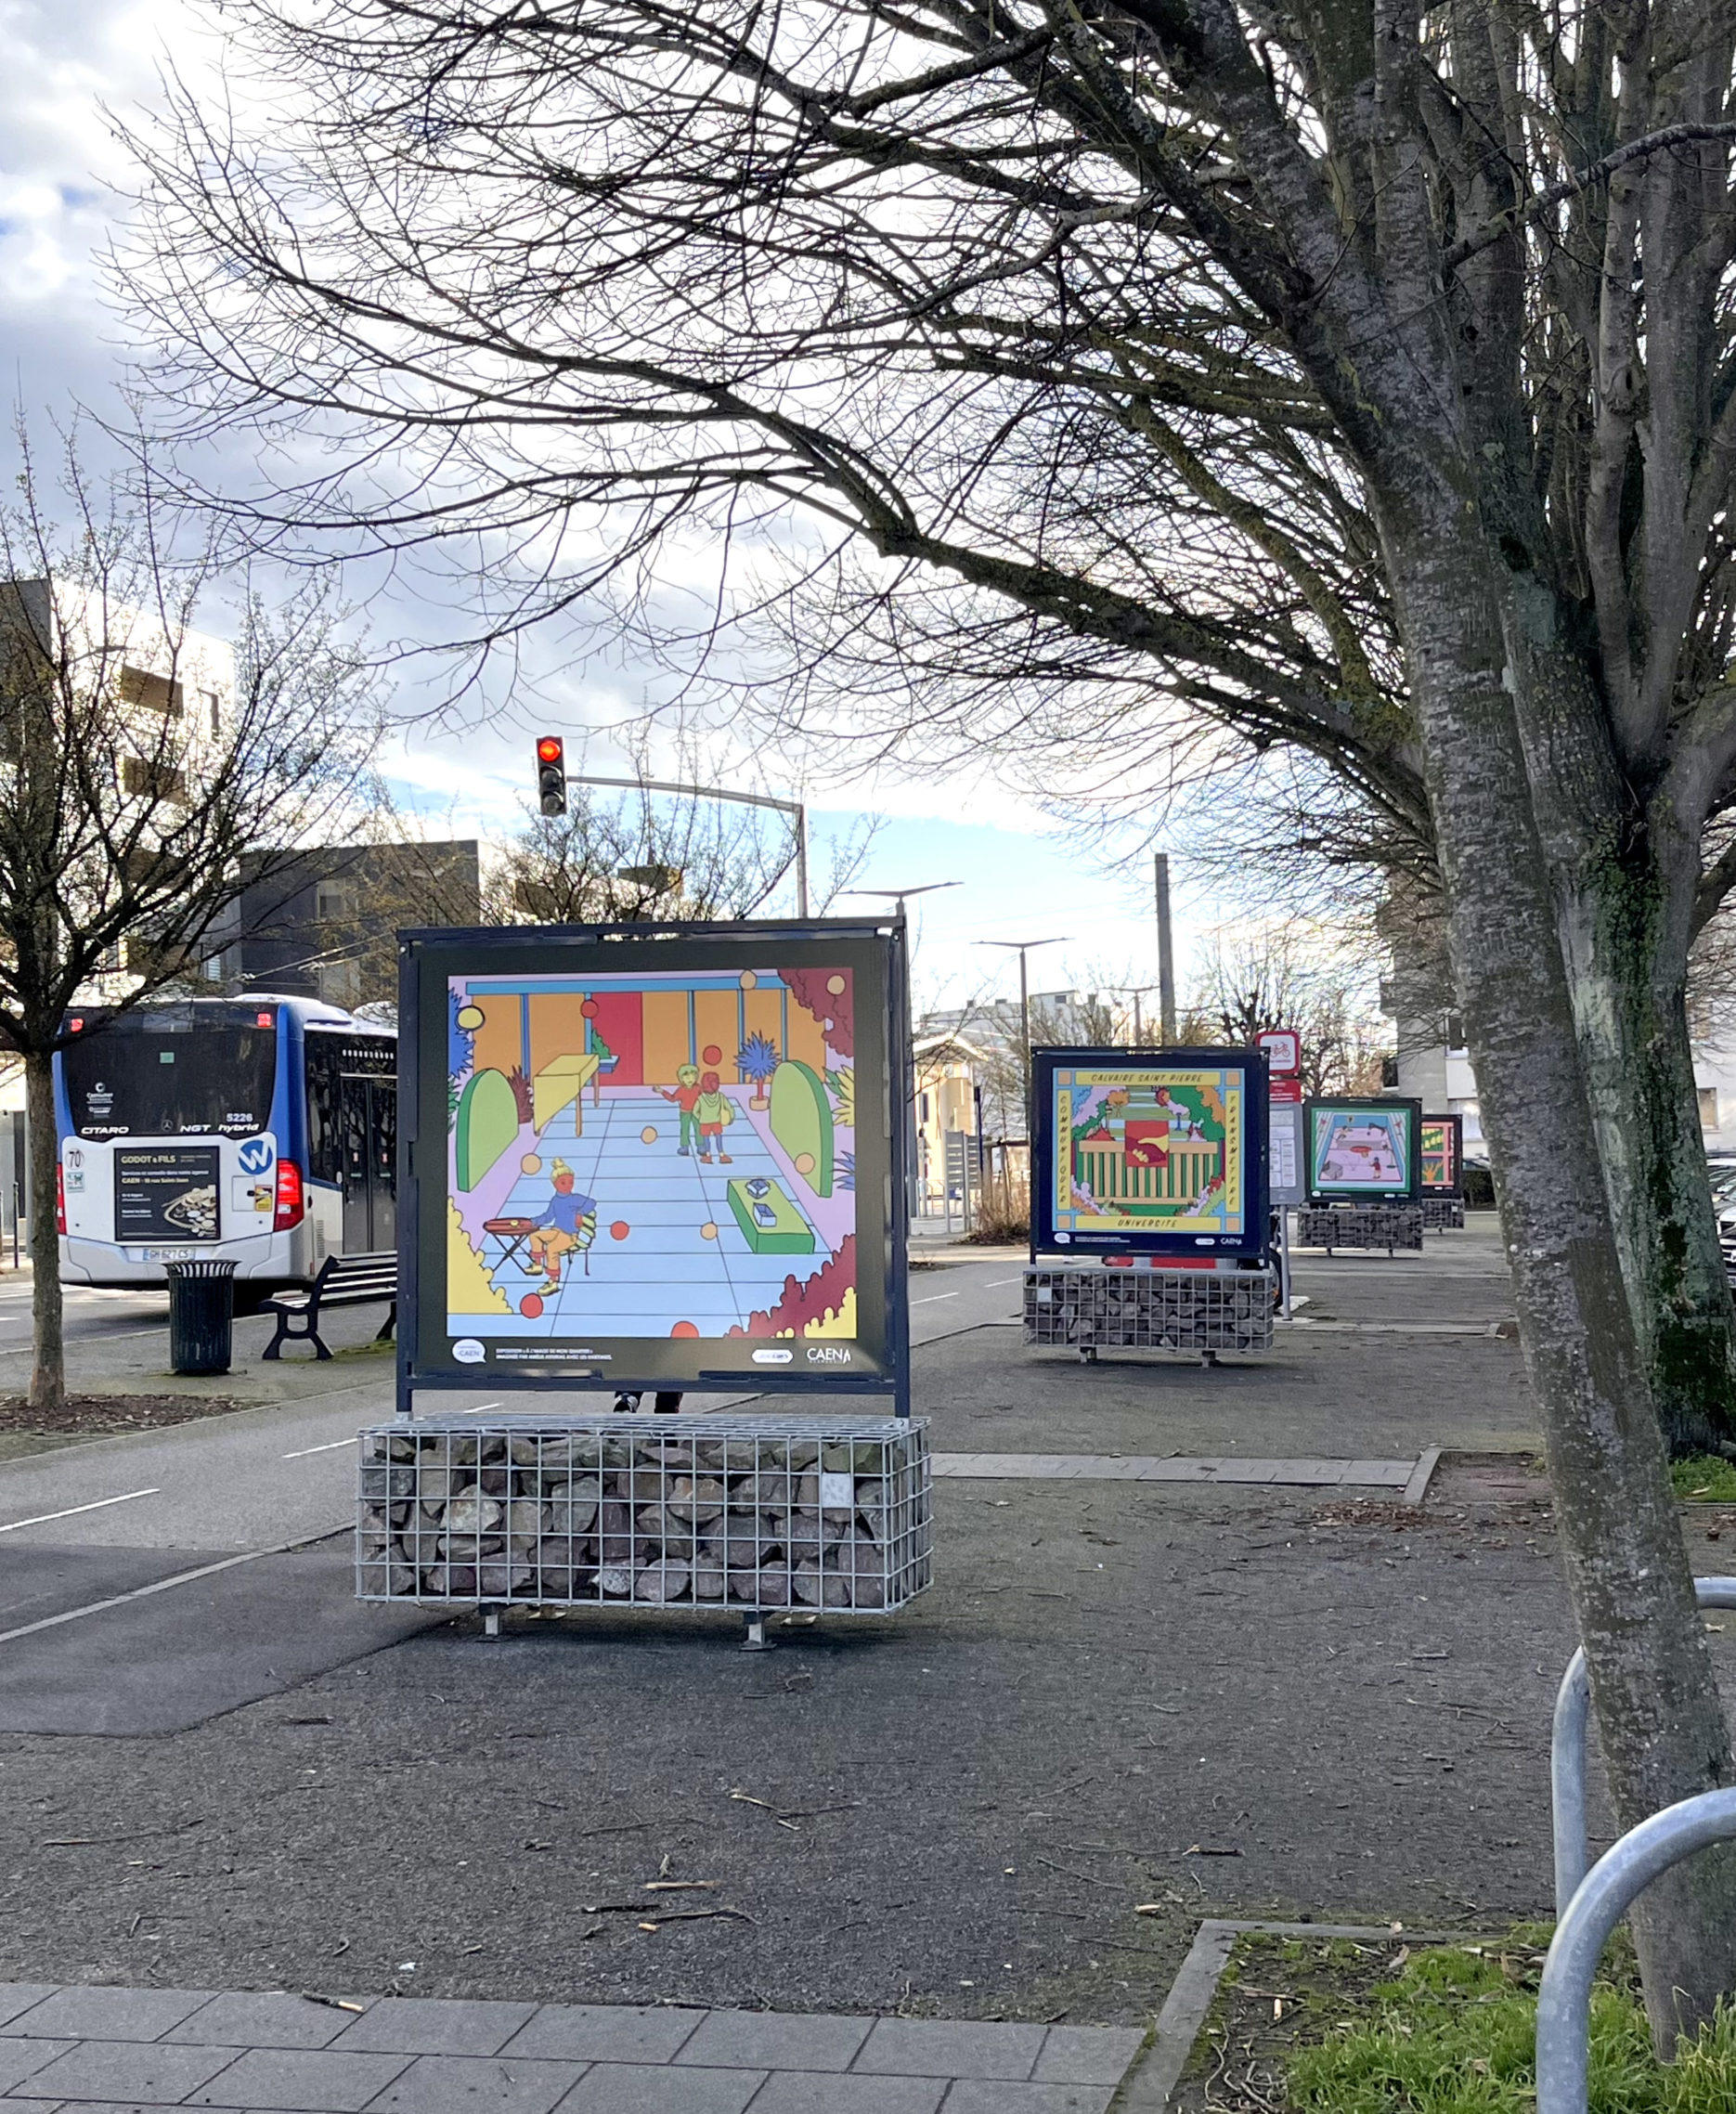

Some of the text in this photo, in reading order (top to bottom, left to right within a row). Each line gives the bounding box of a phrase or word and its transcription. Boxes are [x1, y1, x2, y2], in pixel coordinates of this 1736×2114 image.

[1091, 1073, 1203, 1083] CALVAIRE SAINT PIERRE
[227, 1113, 253, 1122] 5226
[81, 1126, 130, 1135] CITARO
[218, 1123, 259, 1133] hybrid
[69, 1150, 81, 1167] 70
[121, 1155, 151, 1163] GODOT
[158, 1155, 176, 1163] FILS
[807, 1348, 843, 1360] CAEN
